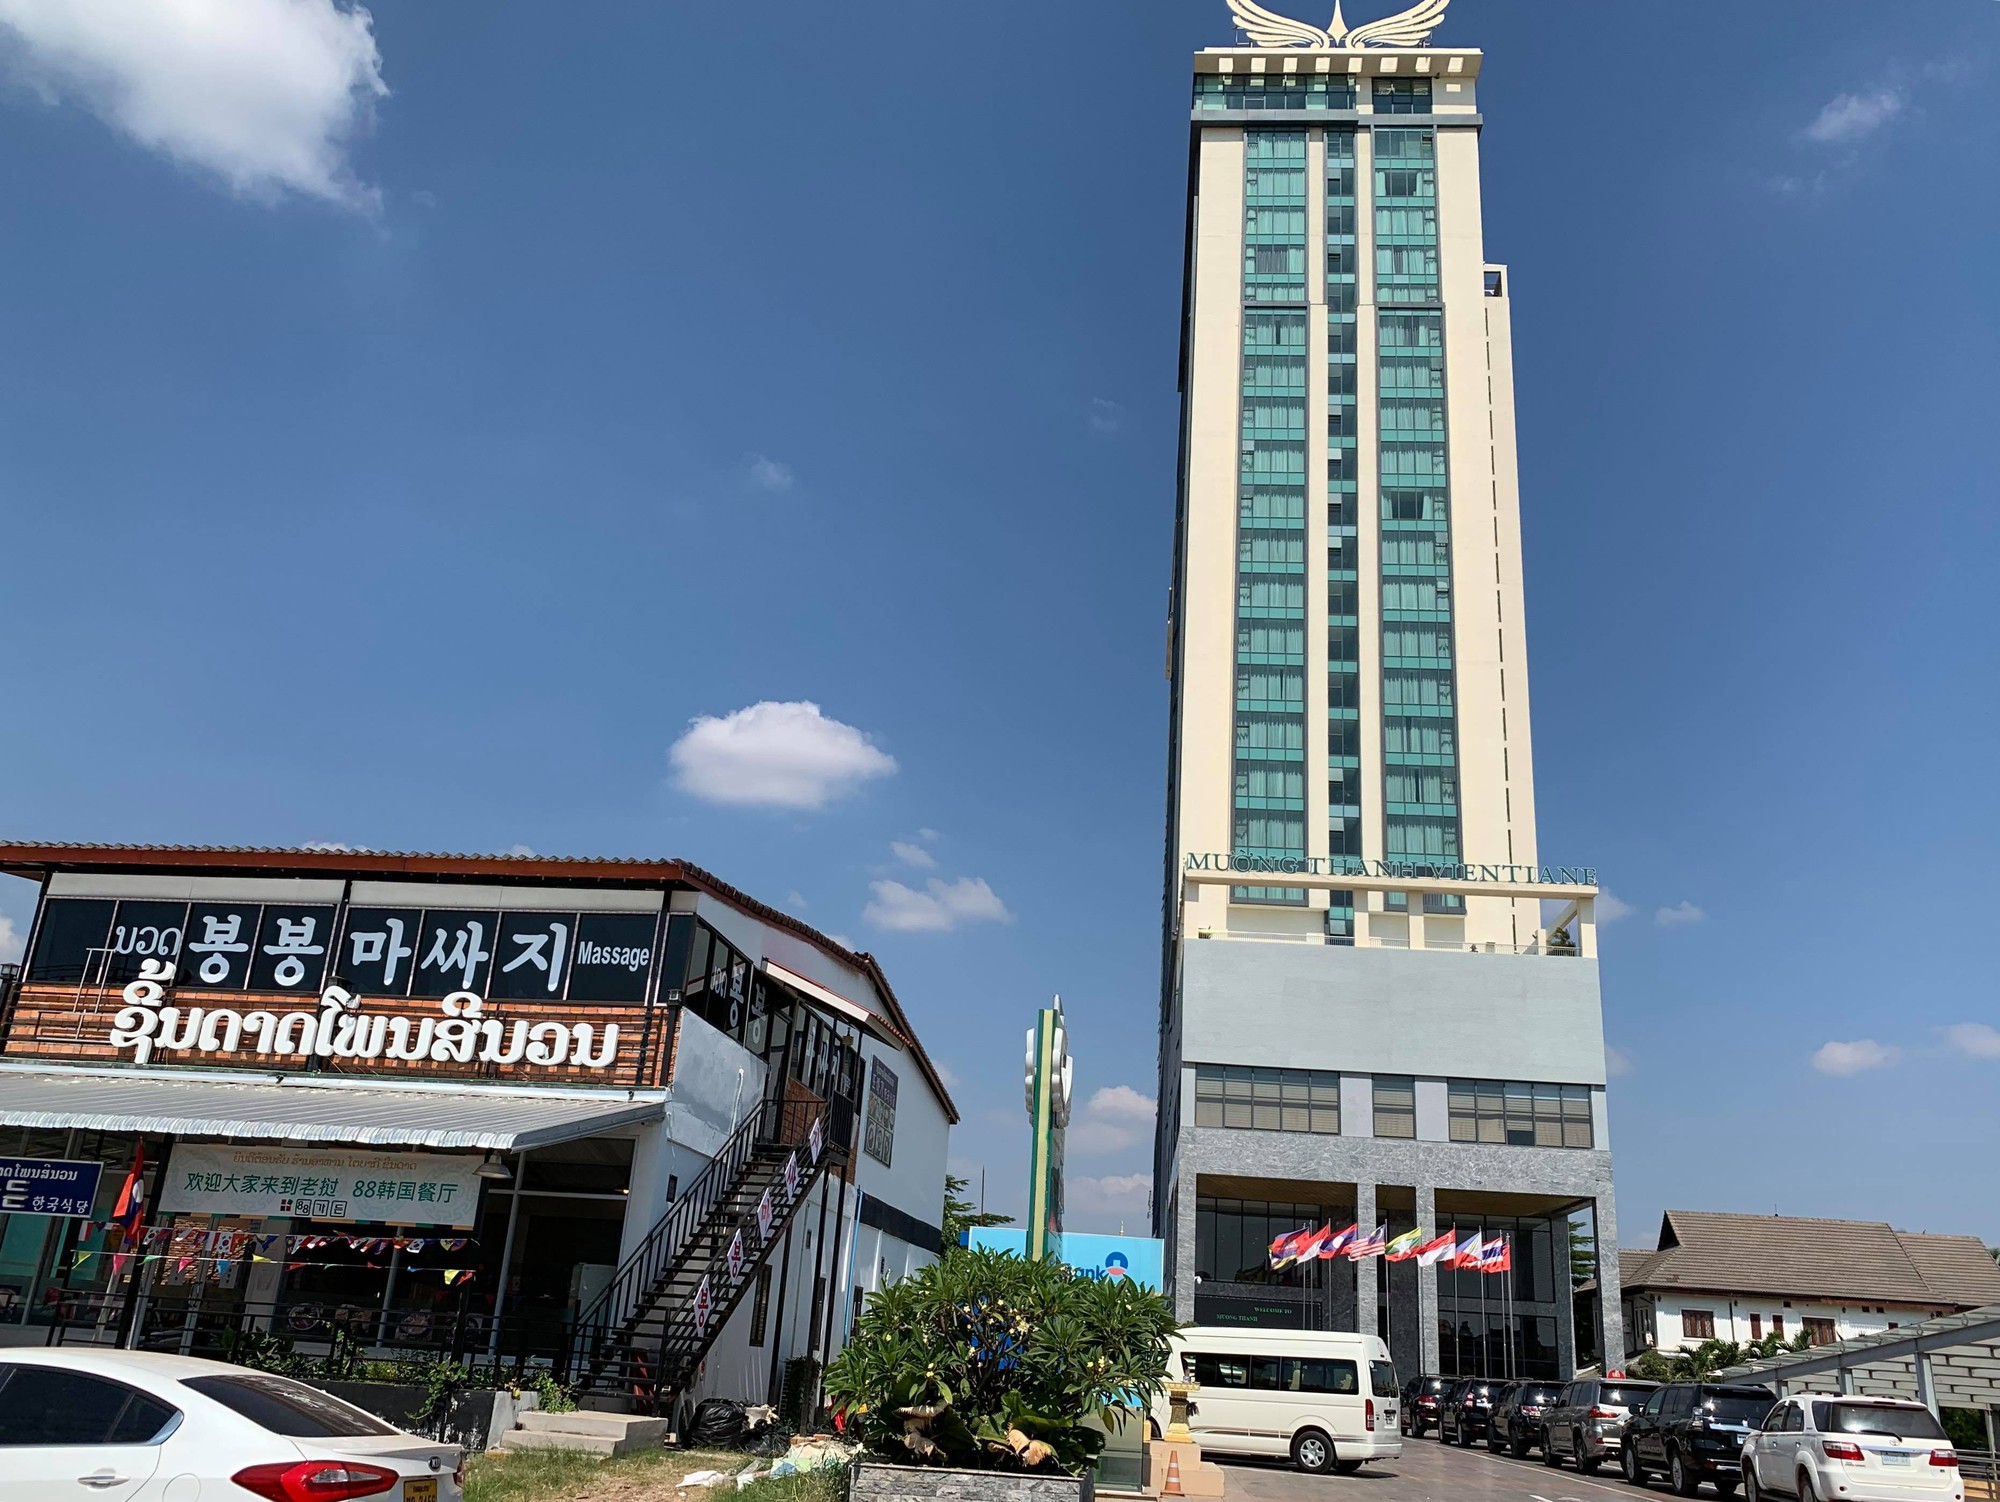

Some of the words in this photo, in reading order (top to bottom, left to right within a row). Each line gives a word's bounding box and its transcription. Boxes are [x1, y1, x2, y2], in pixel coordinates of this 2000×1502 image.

[1307, 857, 1418, 879] THANH
[1428, 862, 1598, 886] VIENTIANE
[578, 941, 650, 972] Massage
[184, 1172, 339, 1198] 欢迎大家来到老挝
[352, 1180, 459, 1203] 88韩国餐厅
[32, 1196, 89, 1214] 한국식당
[1066, 1265, 1105, 1281] ank
[1254, 1306, 1282, 1314] WELCOME
